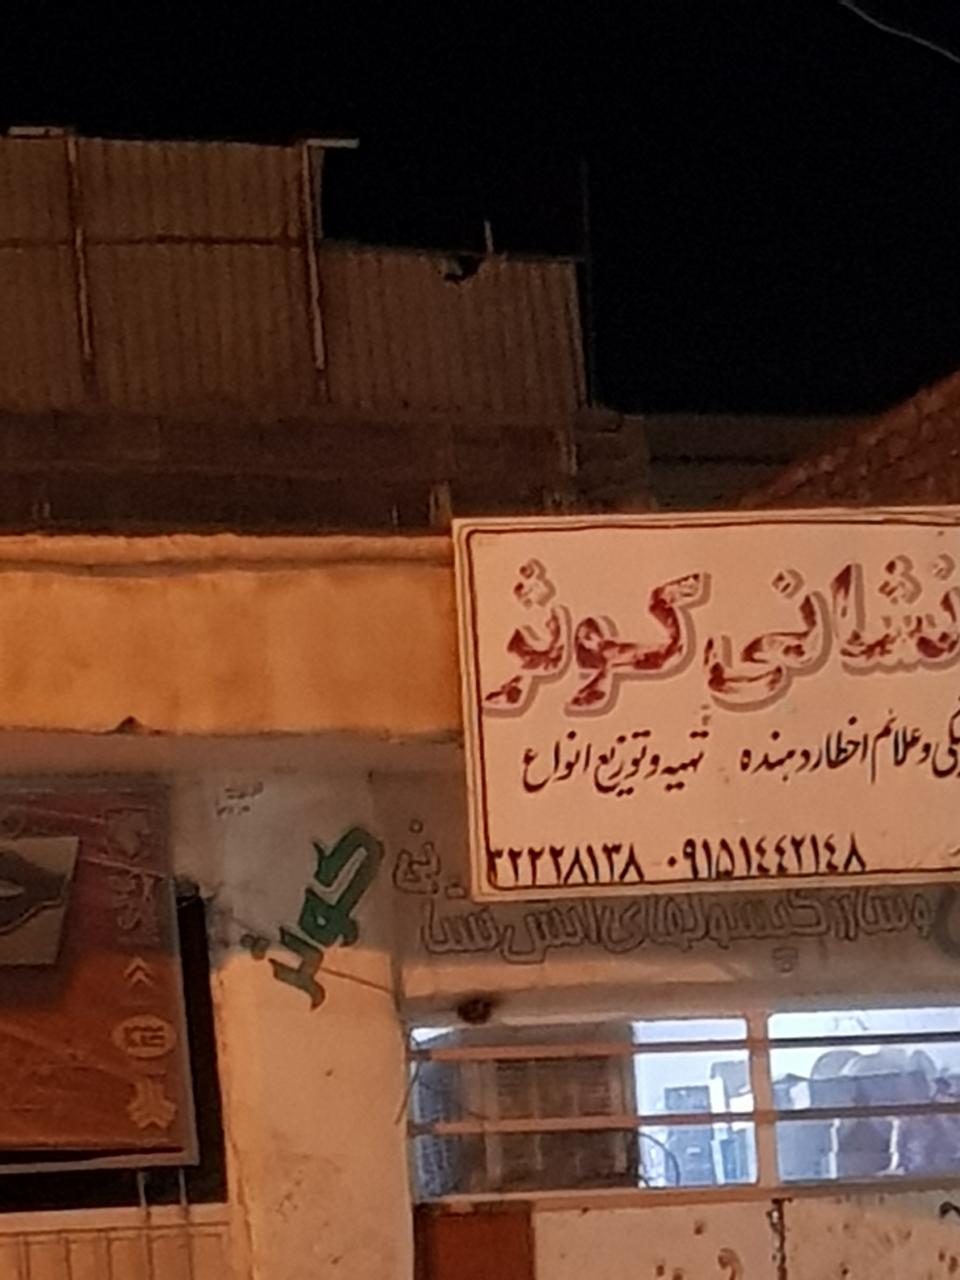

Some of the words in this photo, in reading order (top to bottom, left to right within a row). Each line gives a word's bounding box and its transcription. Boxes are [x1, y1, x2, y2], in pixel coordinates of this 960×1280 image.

[482, 557, 711, 718] کوثر
[523, 730, 592, 793] انواع
[594, 729, 652, 797] توزیع
[645, 753, 661, 780] و
[660, 730, 709, 792] تهیه
[739, 730, 810, 782] دهنده
[809, 716, 869, 773] اخطار
